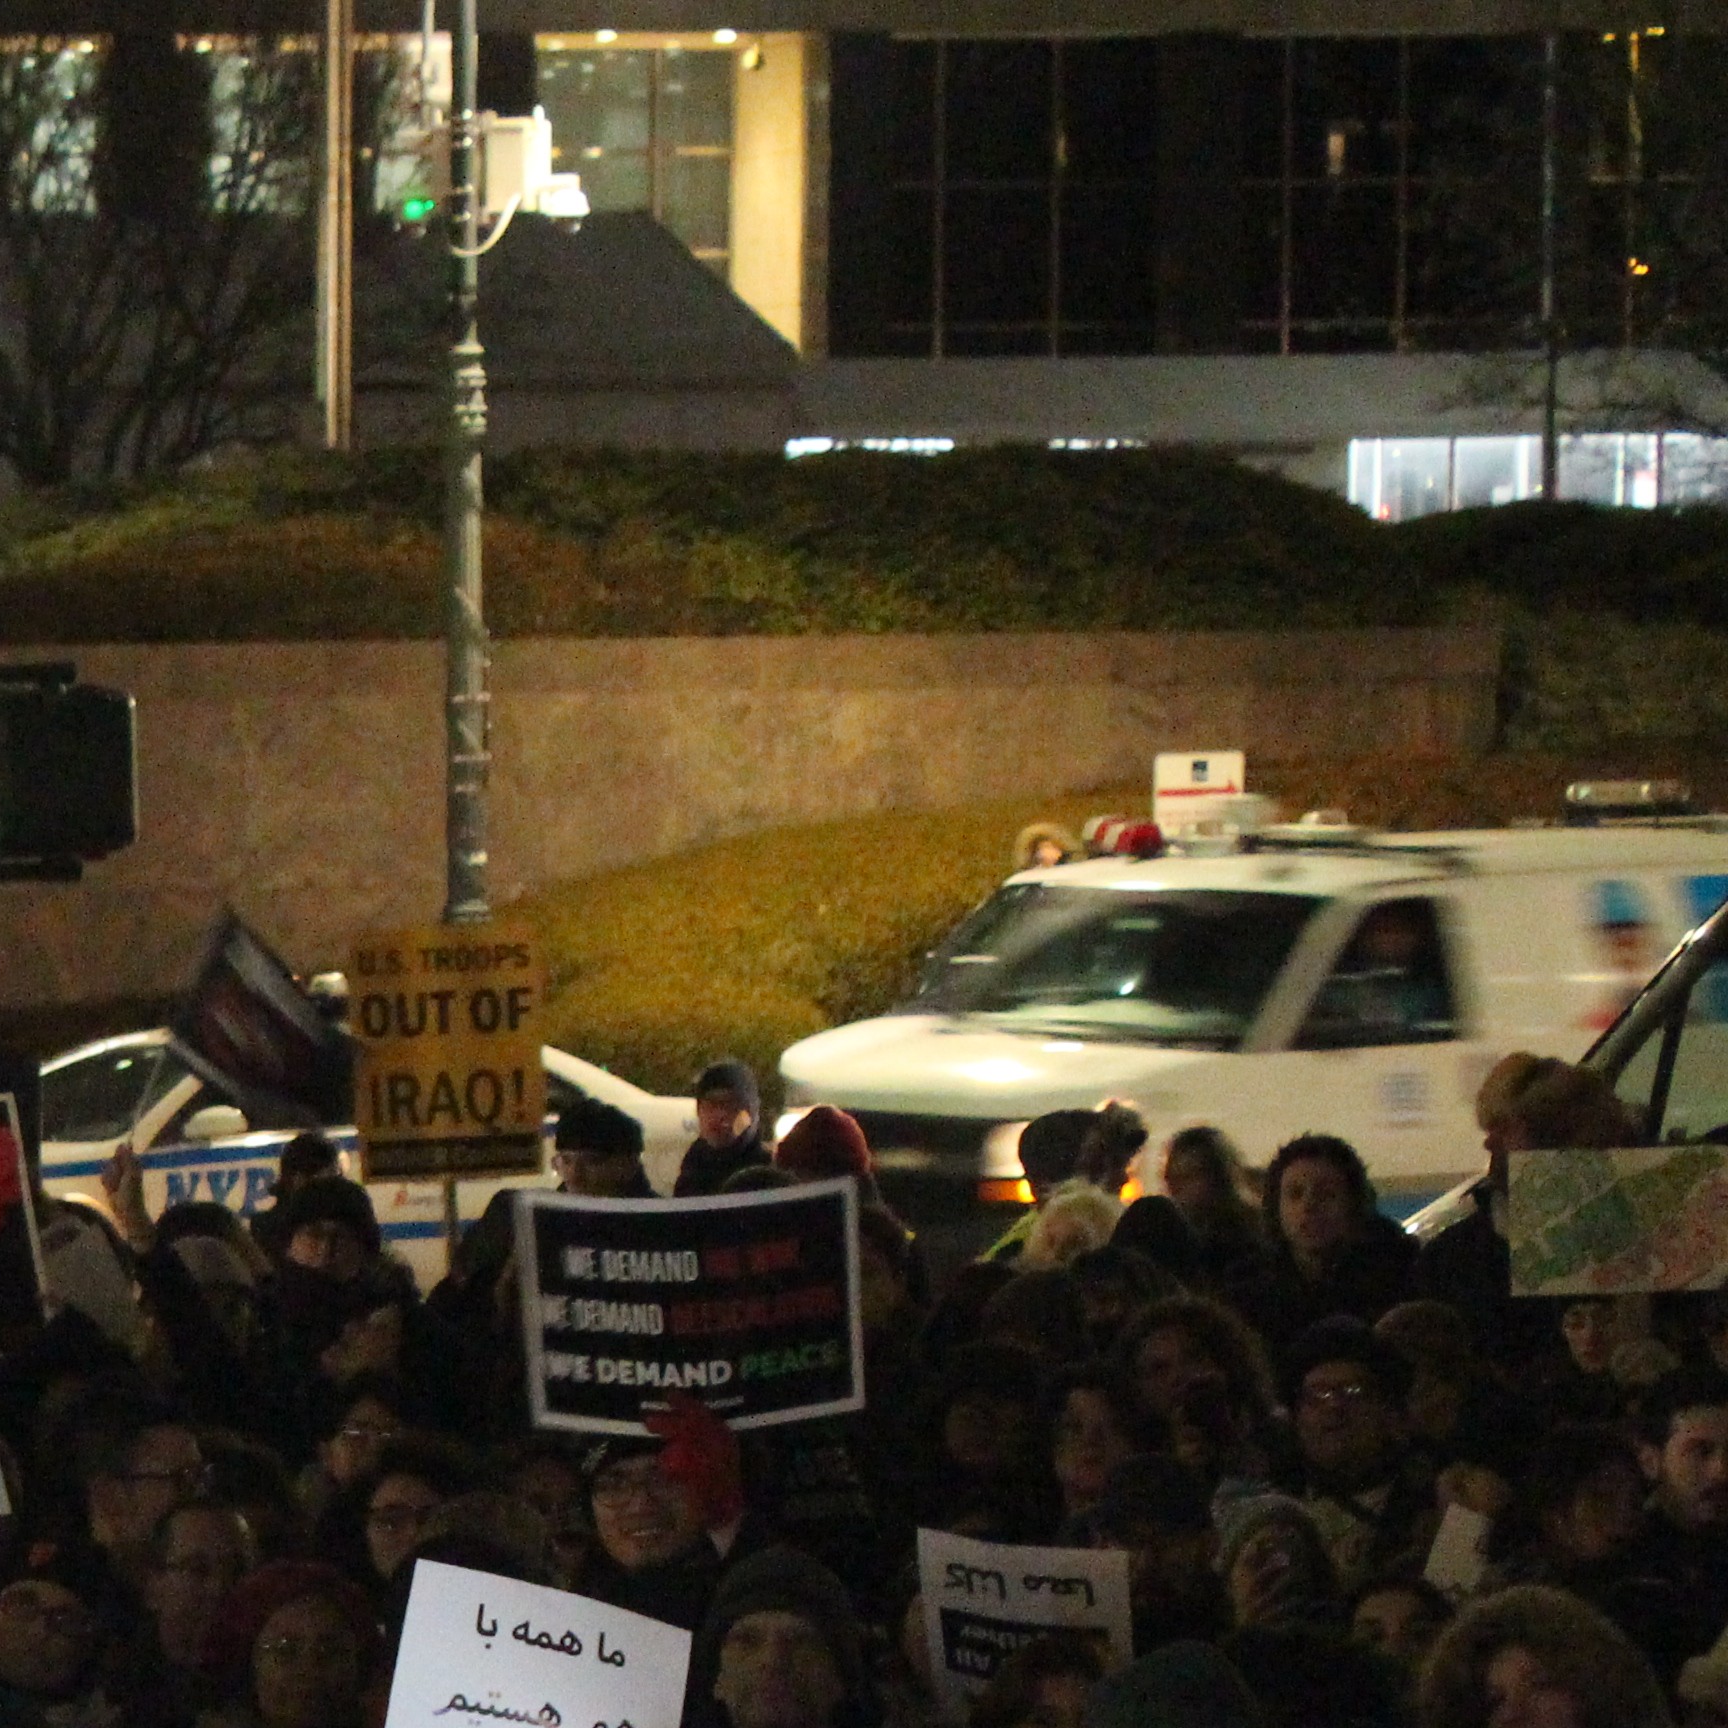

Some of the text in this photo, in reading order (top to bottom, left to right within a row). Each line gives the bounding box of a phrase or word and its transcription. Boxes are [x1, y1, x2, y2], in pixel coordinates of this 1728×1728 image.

[417, 942, 533, 973] TROOPS
[360, 985, 534, 1040] OUT OF
[371, 1066, 528, 1130] IRAQ!
[164, 1166, 279, 1219] NYP
[600, 1248, 701, 1284] DEMAND
[571, 1297, 666, 1336] DEMAND
[544, 1338, 844, 1389] WE DEMAND PEACE
[474, 1602, 627, 1668] ما همه با
